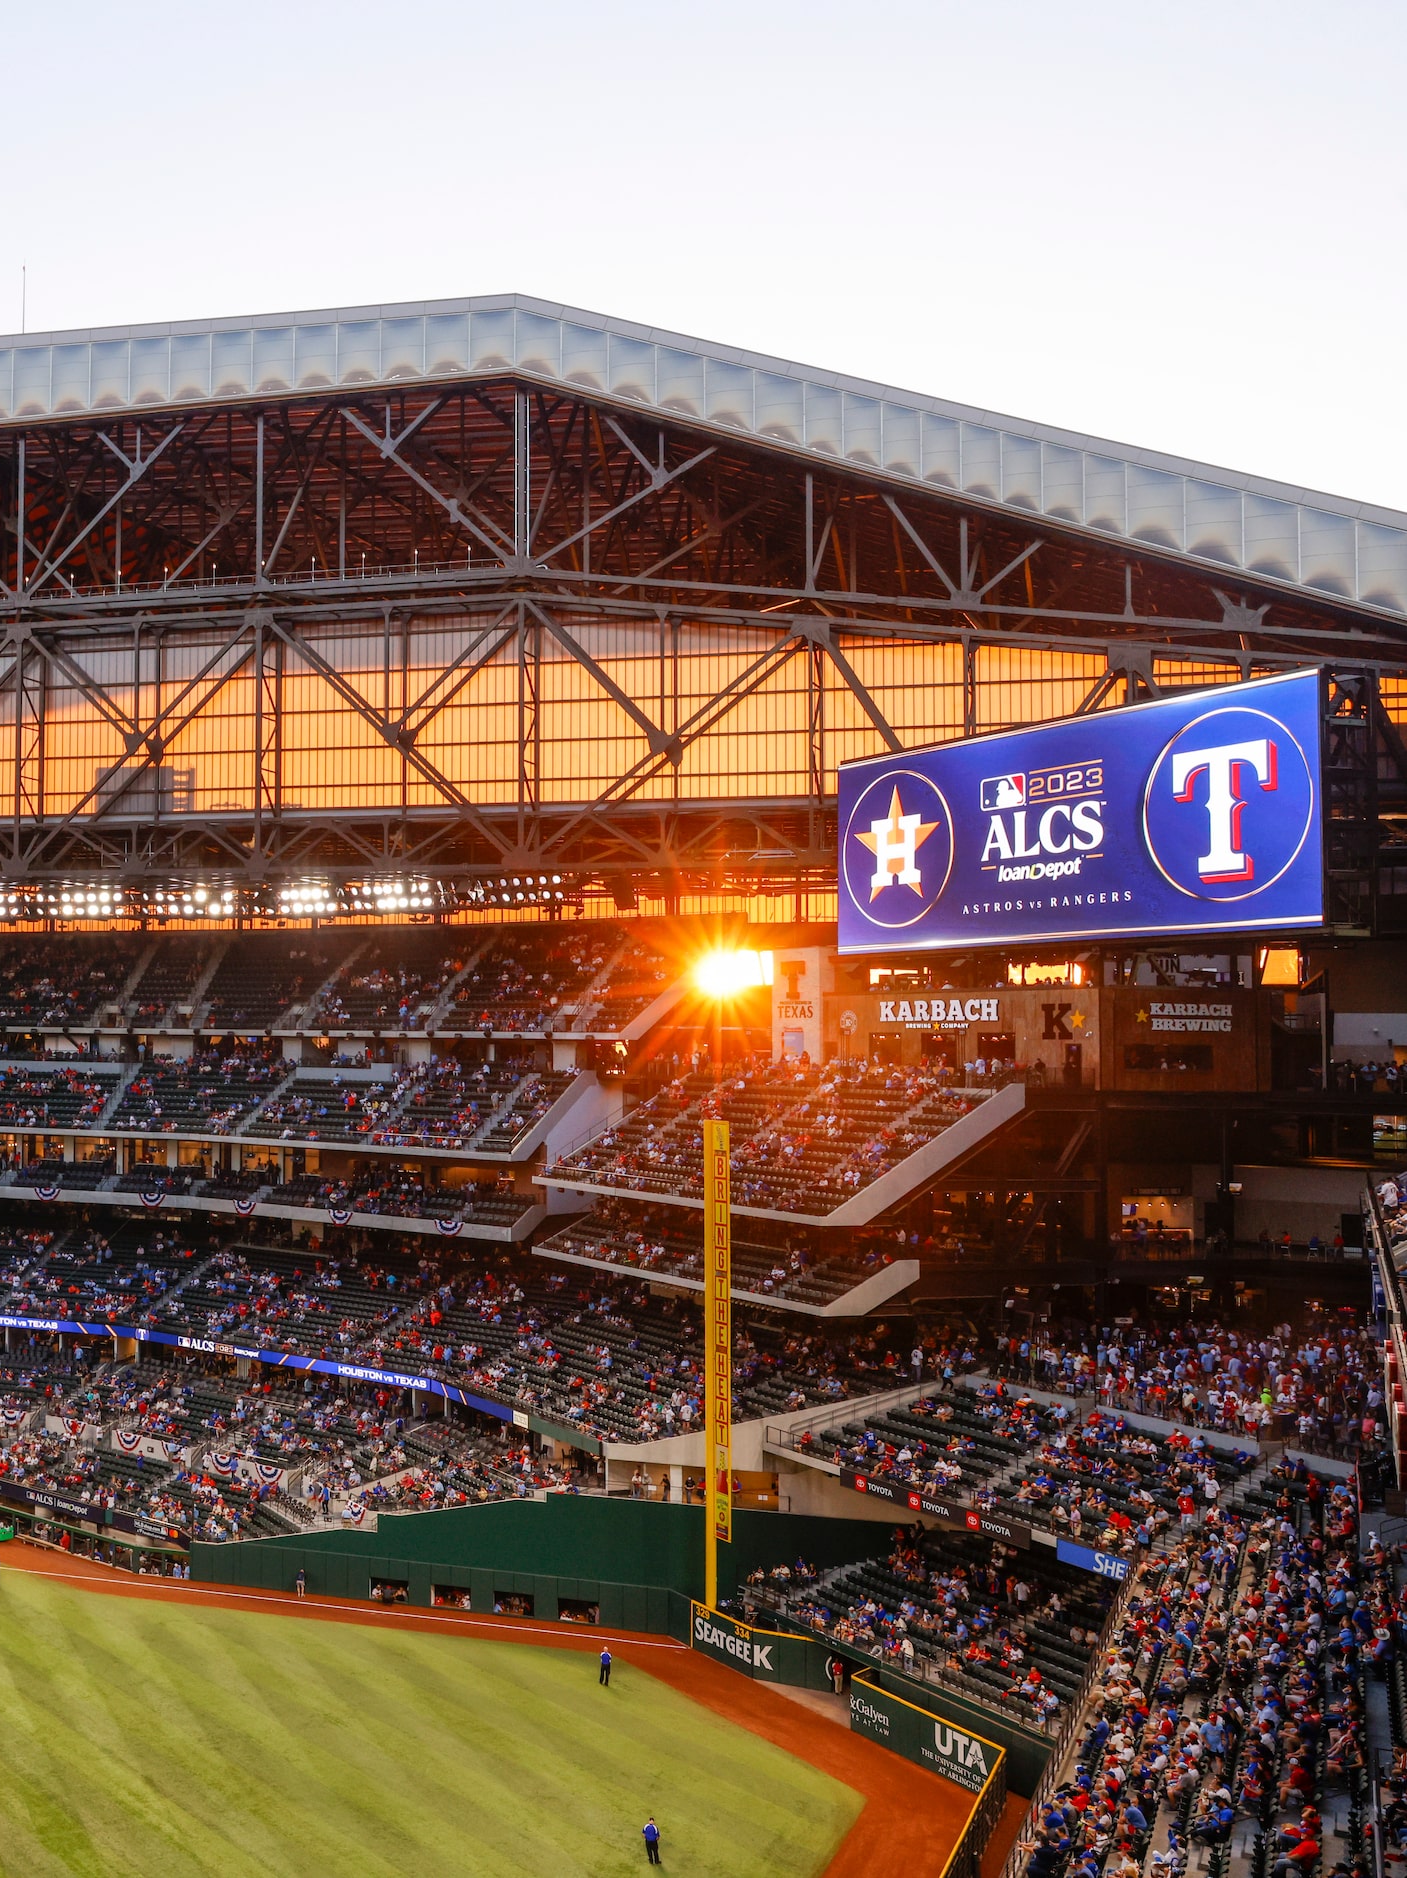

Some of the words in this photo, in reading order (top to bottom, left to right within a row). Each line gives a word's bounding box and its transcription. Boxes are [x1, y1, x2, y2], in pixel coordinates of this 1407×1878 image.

[1029, 767, 1104, 797] 2023
[1172, 739, 1278, 885] T
[980, 800, 1105, 862] ALCS
[997, 857, 1083, 883] loanDepot
[962, 900, 1024, 915] ASTROS
[1050, 890, 1133, 908] RANGERS
[776, 1005, 814, 1019] TEXAS
[879, 998, 1000, 1023] KARBACH
[1041, 1003, 1074, 1040] K
[1149, 1002, 1233, 1017] KARBACH
[1151, 1018, 1233, 1032] BREWING
[27, 1319, 58, 1330] TEXAS
[190, 1338, 215, 1352] ALCS
[337, 1365, 383, 1381] HOUSTON
[393, 1374, 428, 1389] TEXAS
[867, 1482, 893, 1498] TOYOTA
[35, 1492, 54, 1507] ALCS
[56, 1500, 89, 1516] loanDepot
[921, 1500, 950, 1517] TOYOTA
[980, 1519, 1012, 1538] TOYOTA
[1092, 1552, 1128, 1581] SHE
[695, 1605, 711, 1621] 329
[694, 1616, 775, 1672] SEATGEEK
[734, 1624, 751, 1641] 334
[862, 1718, 871, 1728] AT
[874, 1724, 890, 1737] LAW
[934, 1721, 989, 1777] UTA
[920, 1747, 934, 1762] THE
[934, 1753, 972, 1780] UNIVERSITY
[972, 1773, 982, 1784] OF
[938, 1766, 947, 1775] AT
